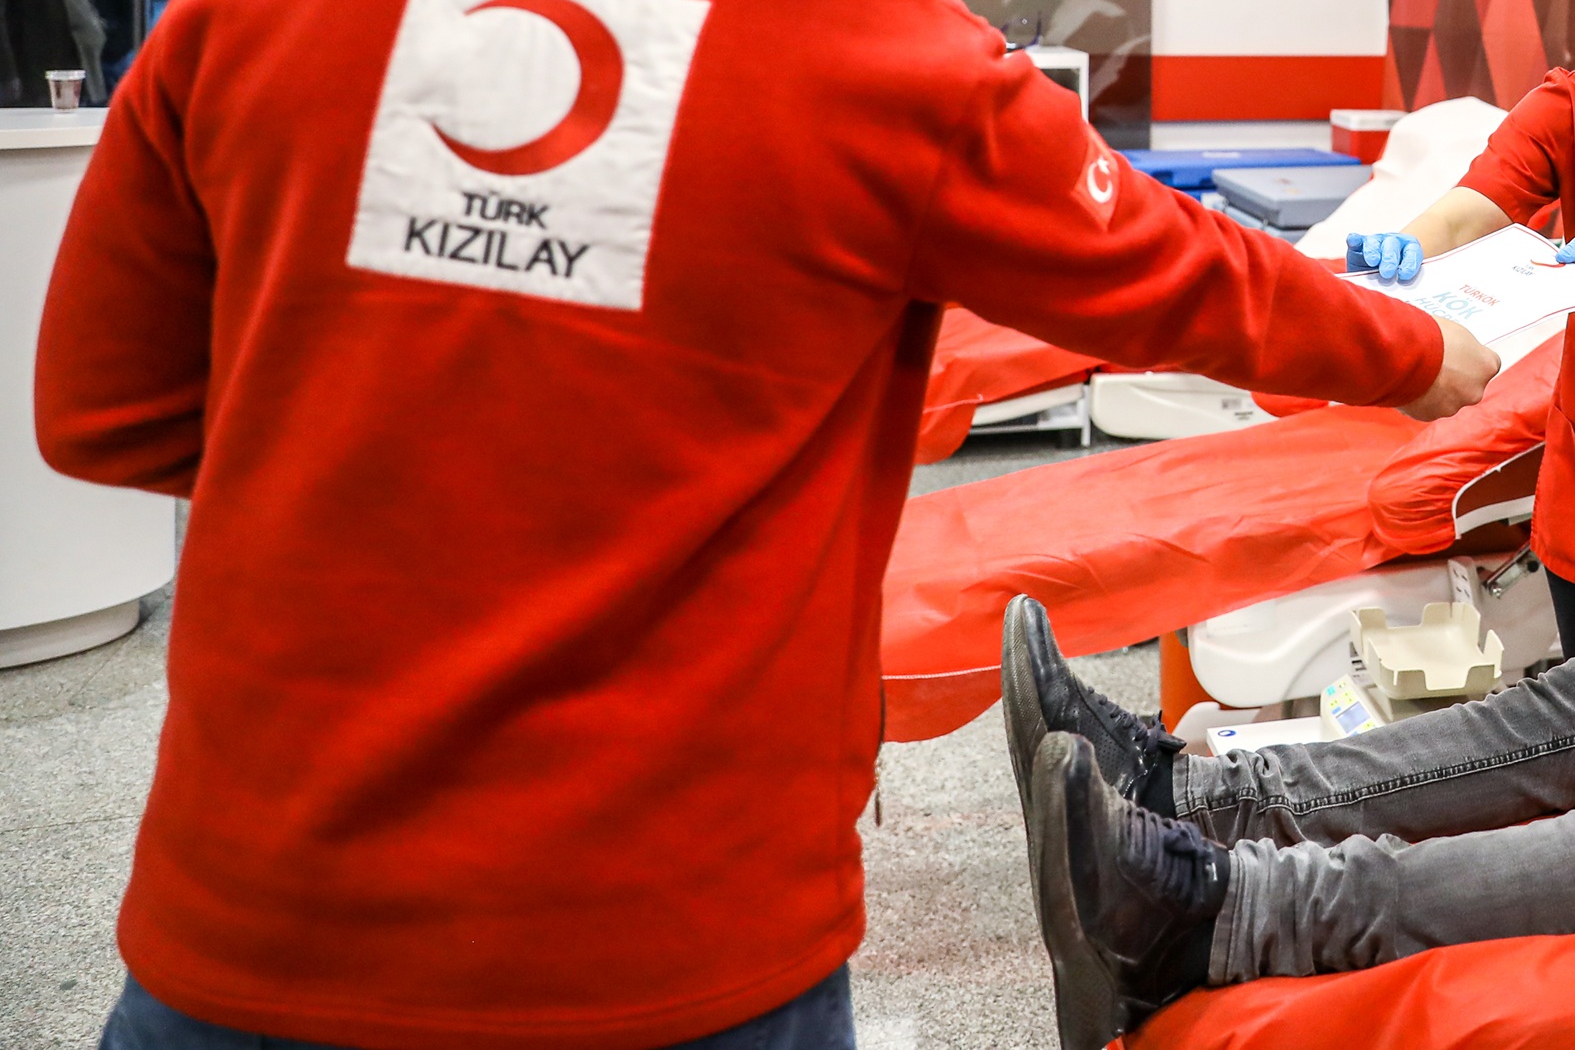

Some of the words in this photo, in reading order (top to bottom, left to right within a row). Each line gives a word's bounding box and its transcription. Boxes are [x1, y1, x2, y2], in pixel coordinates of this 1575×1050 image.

[462, 191, 548, 229] TÜRK
[404, 217, 590, 278] KIZILAY
[1432, 291, 1483, 320] KÖK
